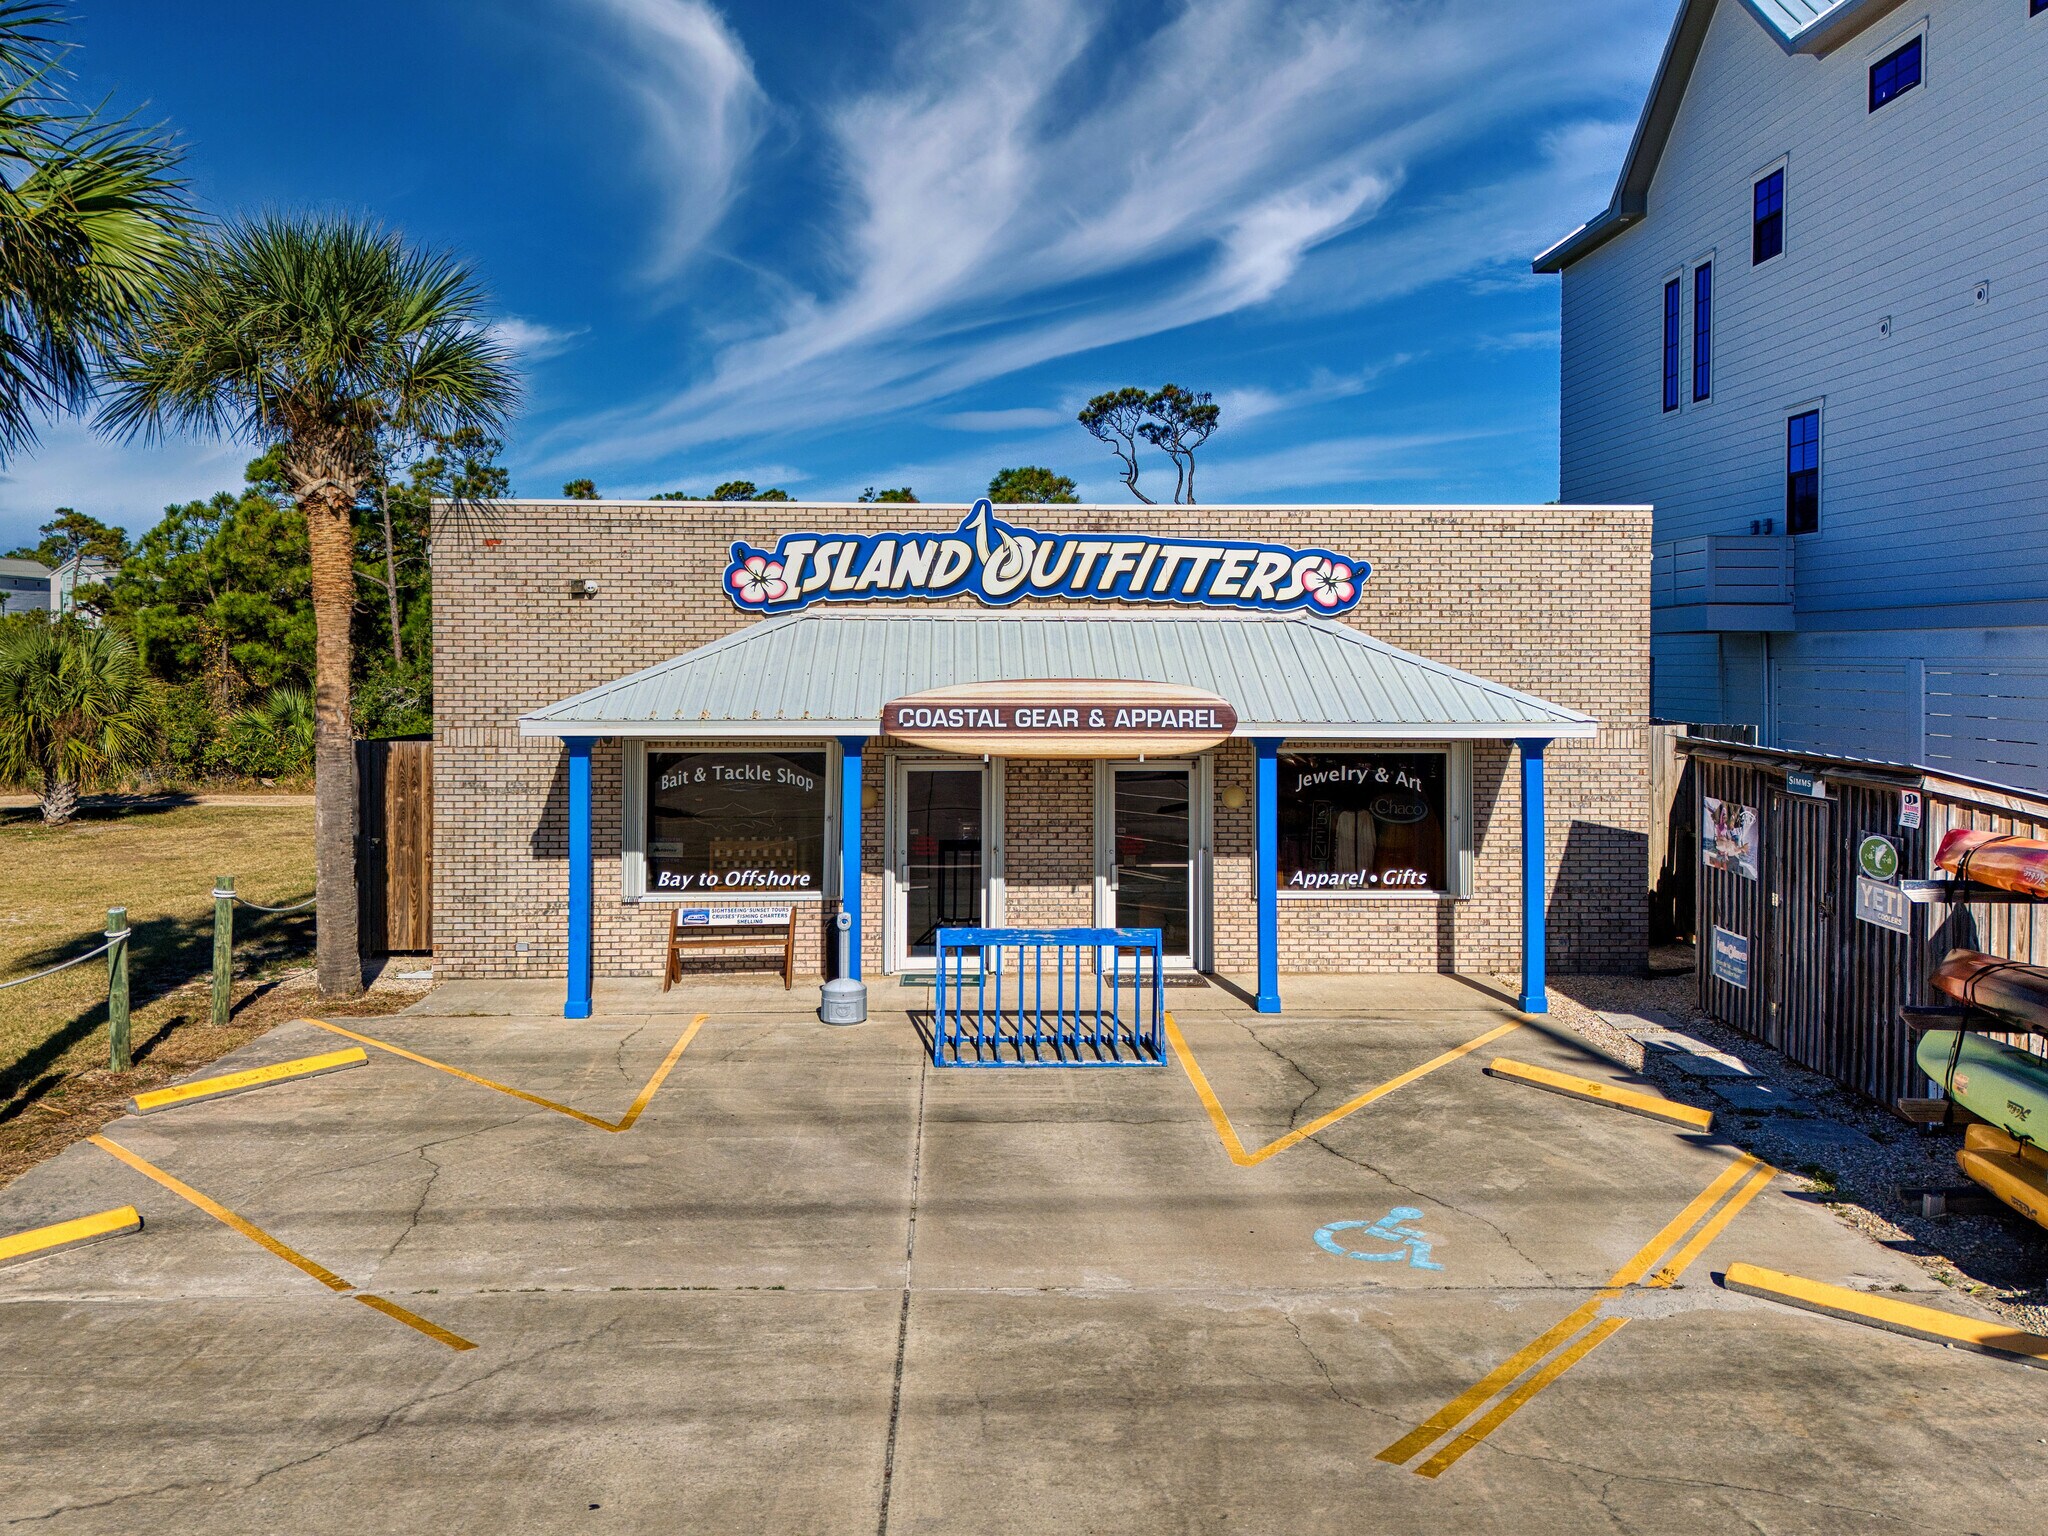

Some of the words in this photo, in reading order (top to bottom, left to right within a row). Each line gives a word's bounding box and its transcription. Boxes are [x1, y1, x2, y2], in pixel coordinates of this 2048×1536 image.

[768, 539, 973, 604] ISLAND
[977, 534, 1322, 602] OUTFITTERS
[898, 708, 1007, 728] COASTAL
[1015, 708, 1079, 728] GEAR
[1088, 708, 1105, 728] &
[1113, 708, 1223, 728] APPAREL
[661, 771, 689, 791] Bait
[694, 766, 707, 783] &
[711, 764, 772, 782] Tackle
[777, 768, 814, 791] Shop
[1295, 766, 1368, 792] Jewelry
[1374, 767, 1390, 783] &
[1395, 771, 1423, 793] Art
[1375, 798, 1423, 816] Chaco
[658, 871, 694, 890] Bay
[699, 872, 718, 887] to
[725, 870, 811, 887] Offshore
[1290, 869, 1367, 889] Apparel
[1382, 868, 1428, 886] Gifts
[1860, 881, 1904, 918] YETI
[1877, 912, 1903, 926] COOLERS
